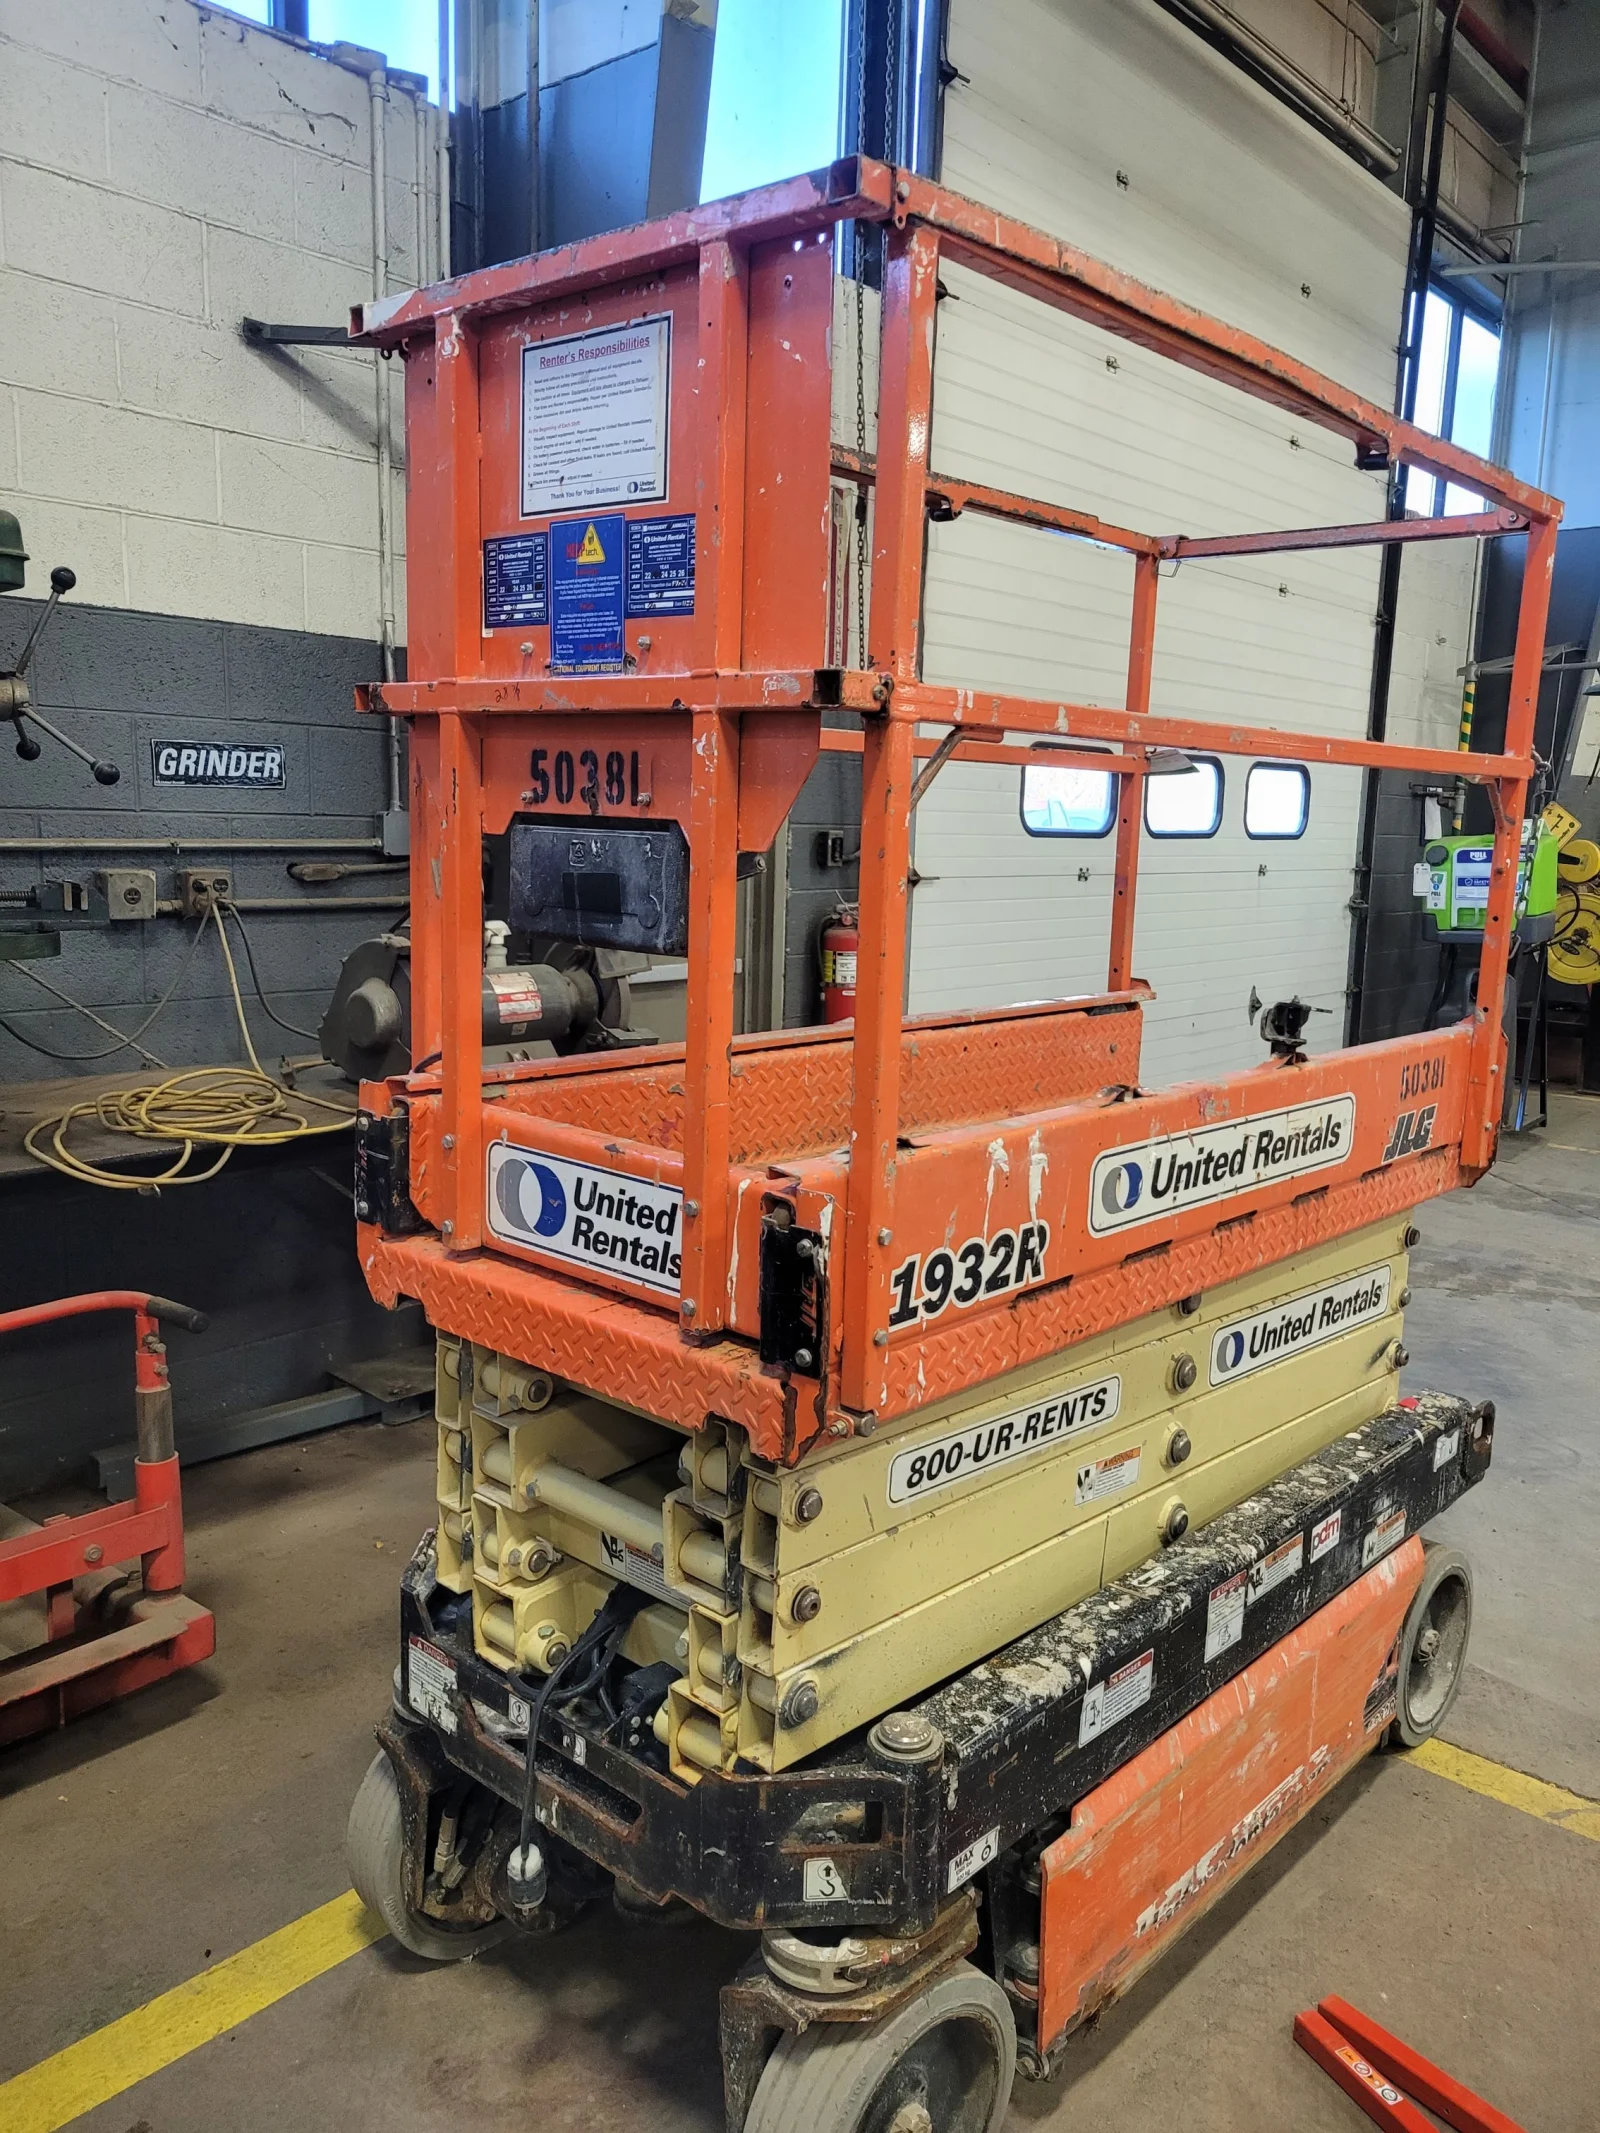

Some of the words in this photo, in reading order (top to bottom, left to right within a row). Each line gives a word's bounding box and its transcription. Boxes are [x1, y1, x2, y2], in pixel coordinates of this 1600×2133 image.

[540, 350, 576, 368] Renter's
[578, 336, 650, 362] Responsibilities
[595, 484, 620, 494] Business!
[639, 478, 655, 486] United
[639, 484, 655, 492] Rentals
[158, 748, 281, 778] GRINDER
[530, 749, 639, 806] 50381
[1400, 1055, 1446, 1101] 50381
[1382, 1103, 1438, 1165] JLG
[1150, 1133, 1250, 1200] United
[1252, 1114, 1342, 1170] Rentals
[574, 1176, 678, 1236] United
[572, 1214, 682, 1278] Rentals
[888, 1224, 1048, 1327] 1932R
[1250, 1302, 1316, 1358] United
[1318, 1279, 1382, 1330] Rentals
[906, 1386, 1108, 1489] 800-UR-RENTS
[1312, 1517, 1339, 1559] pdm
[423, 1644, 449, 1666] DANGER
[1120, 1660, 1142, 1681] DANGER
[954, 1846, 974, 1871] MAX
